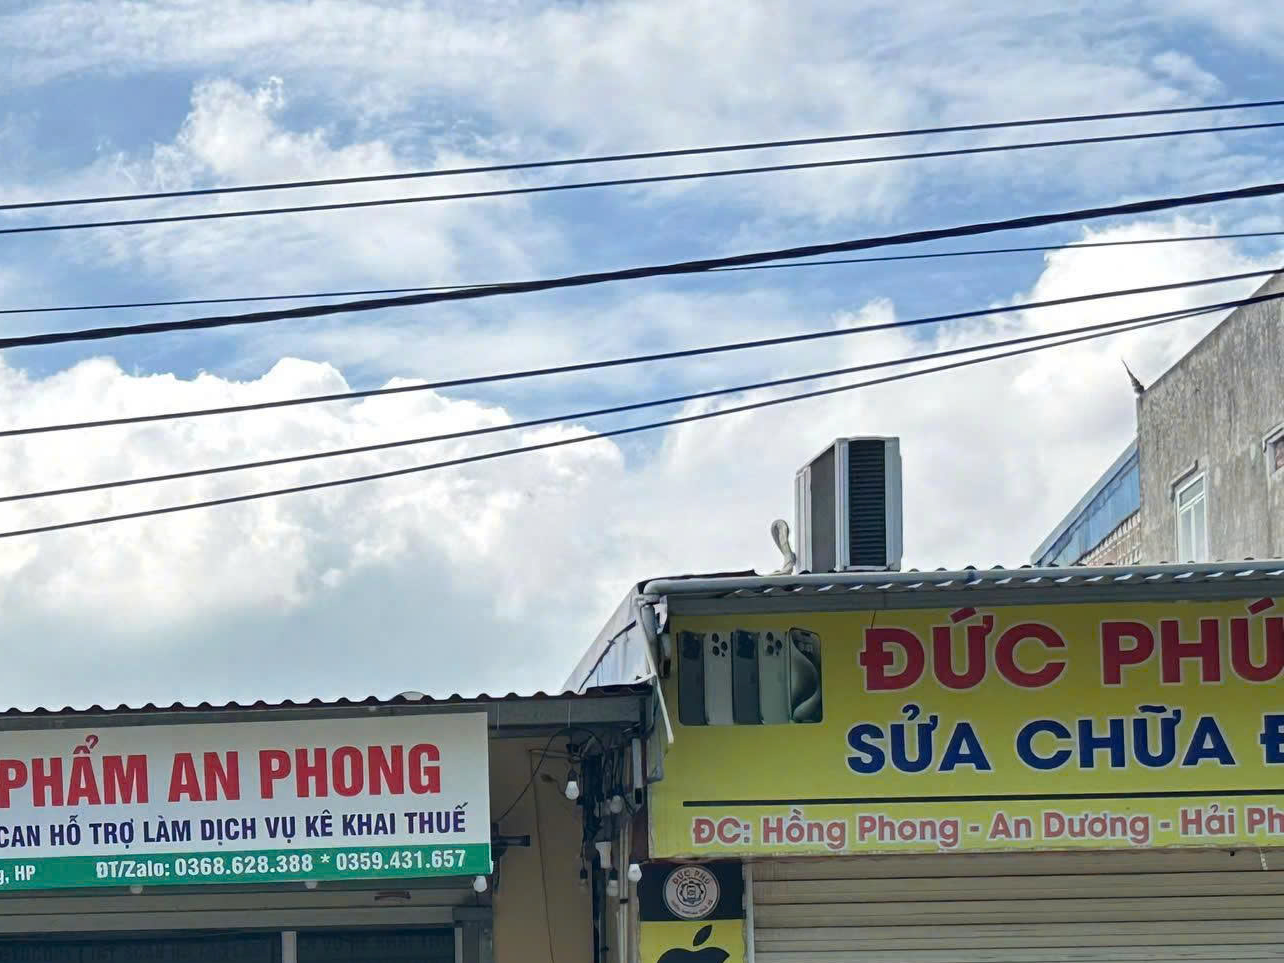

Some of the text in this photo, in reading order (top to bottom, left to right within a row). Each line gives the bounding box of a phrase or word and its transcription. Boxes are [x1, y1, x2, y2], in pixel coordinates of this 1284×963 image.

[860, 606, 1067, 692] ĐỨC
[846, 704, 992, 774] SỬA
[1017, 705, 1236, 770] CHỮA
[168, 750, 241, 803] AN
[259, 743, 442, 800] PHONG
[50, 814, 81, 847] HỖ
[89, 819, 135, 849] TRỢ
[144, 814, 192, 843] LÀM
[201, 817, 256, 846] DỊCH
[265, 816, 296, 844] VỤ
[306, 808, 333, 839] KÊ
[342, 812, 396, 836] KHAI
[406, 802, 469, 834] THUẾ
[693, 816, 751, 847] ĐC:
[761, 807, 846, 850] Hồng
[858, 814, 959, 849] Phong
[989, 812, 1032, 840] An
[1043, 810, 1150, 847] Dương
[1180, 803, 1236, 836] Hải
[15, 865, 36, 881] HP
[96, 850, 466, 879] ĐT/Zalo: 0368.628.388 0359.431.657
